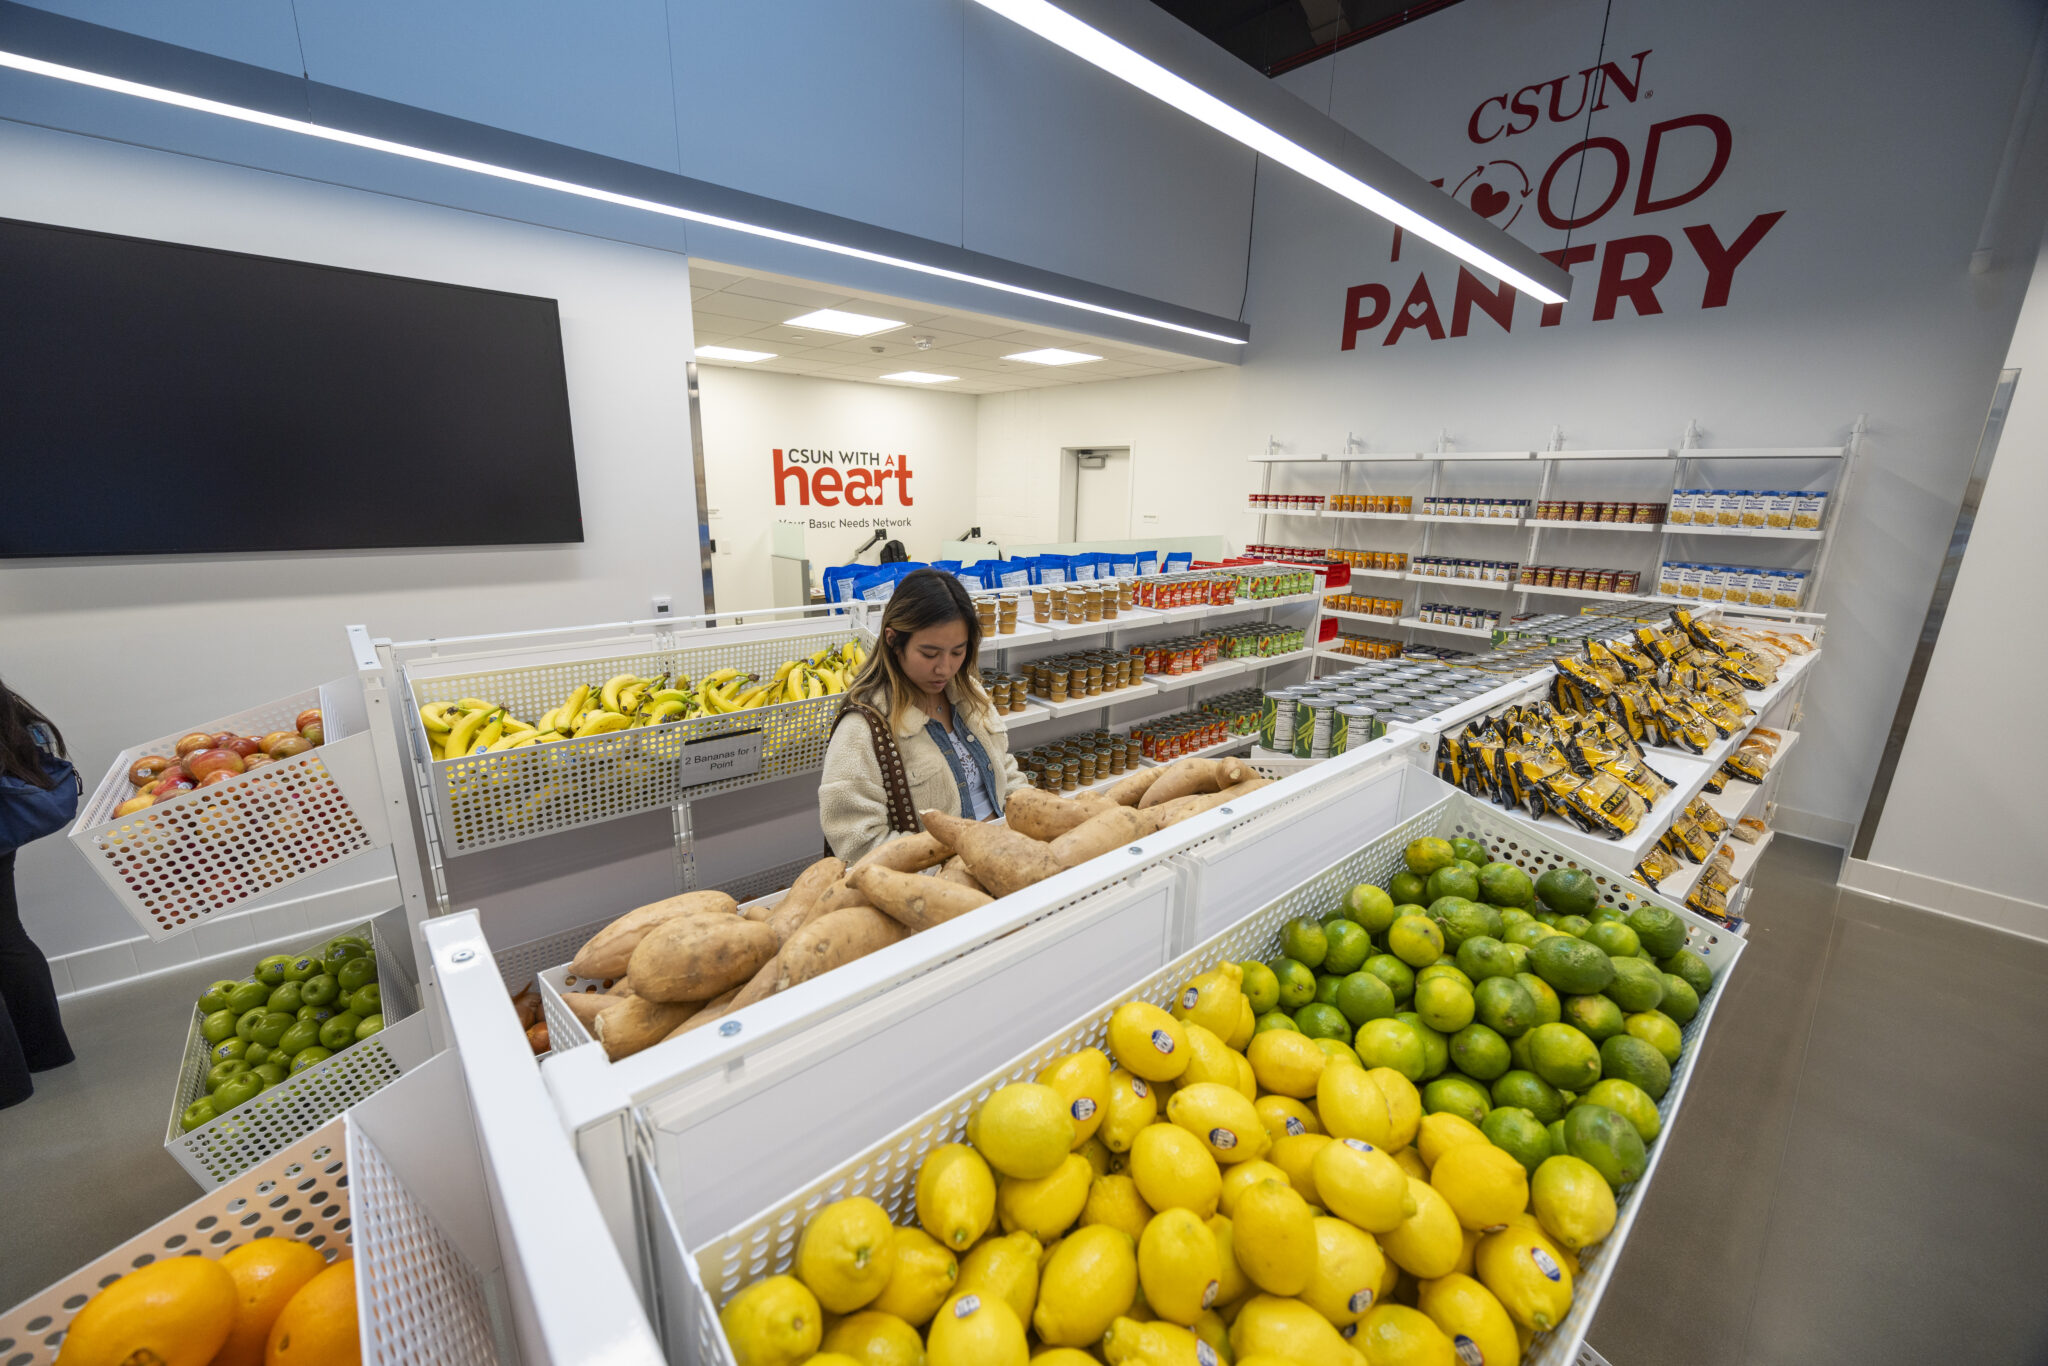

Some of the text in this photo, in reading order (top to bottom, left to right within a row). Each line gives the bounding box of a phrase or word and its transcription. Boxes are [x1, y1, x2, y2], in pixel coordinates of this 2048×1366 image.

[1467, 49, 1653, 144] CSUN
[1390, 113, 1732, 263] OD
[1340, 210, 1787, 351] PANTRY
[788, 449, 895, 467] CSUN WITH A
[772, 448, 913, 507] heart
[809, 519, 836, 529] Basic
[839, 518, 870, 528] Needs
[872, 517, 912, 528] Network
[685, 757, 691, 765] 2
[694, 751, 735, 764] Bananas
[710, 760, 734, 770] Point
